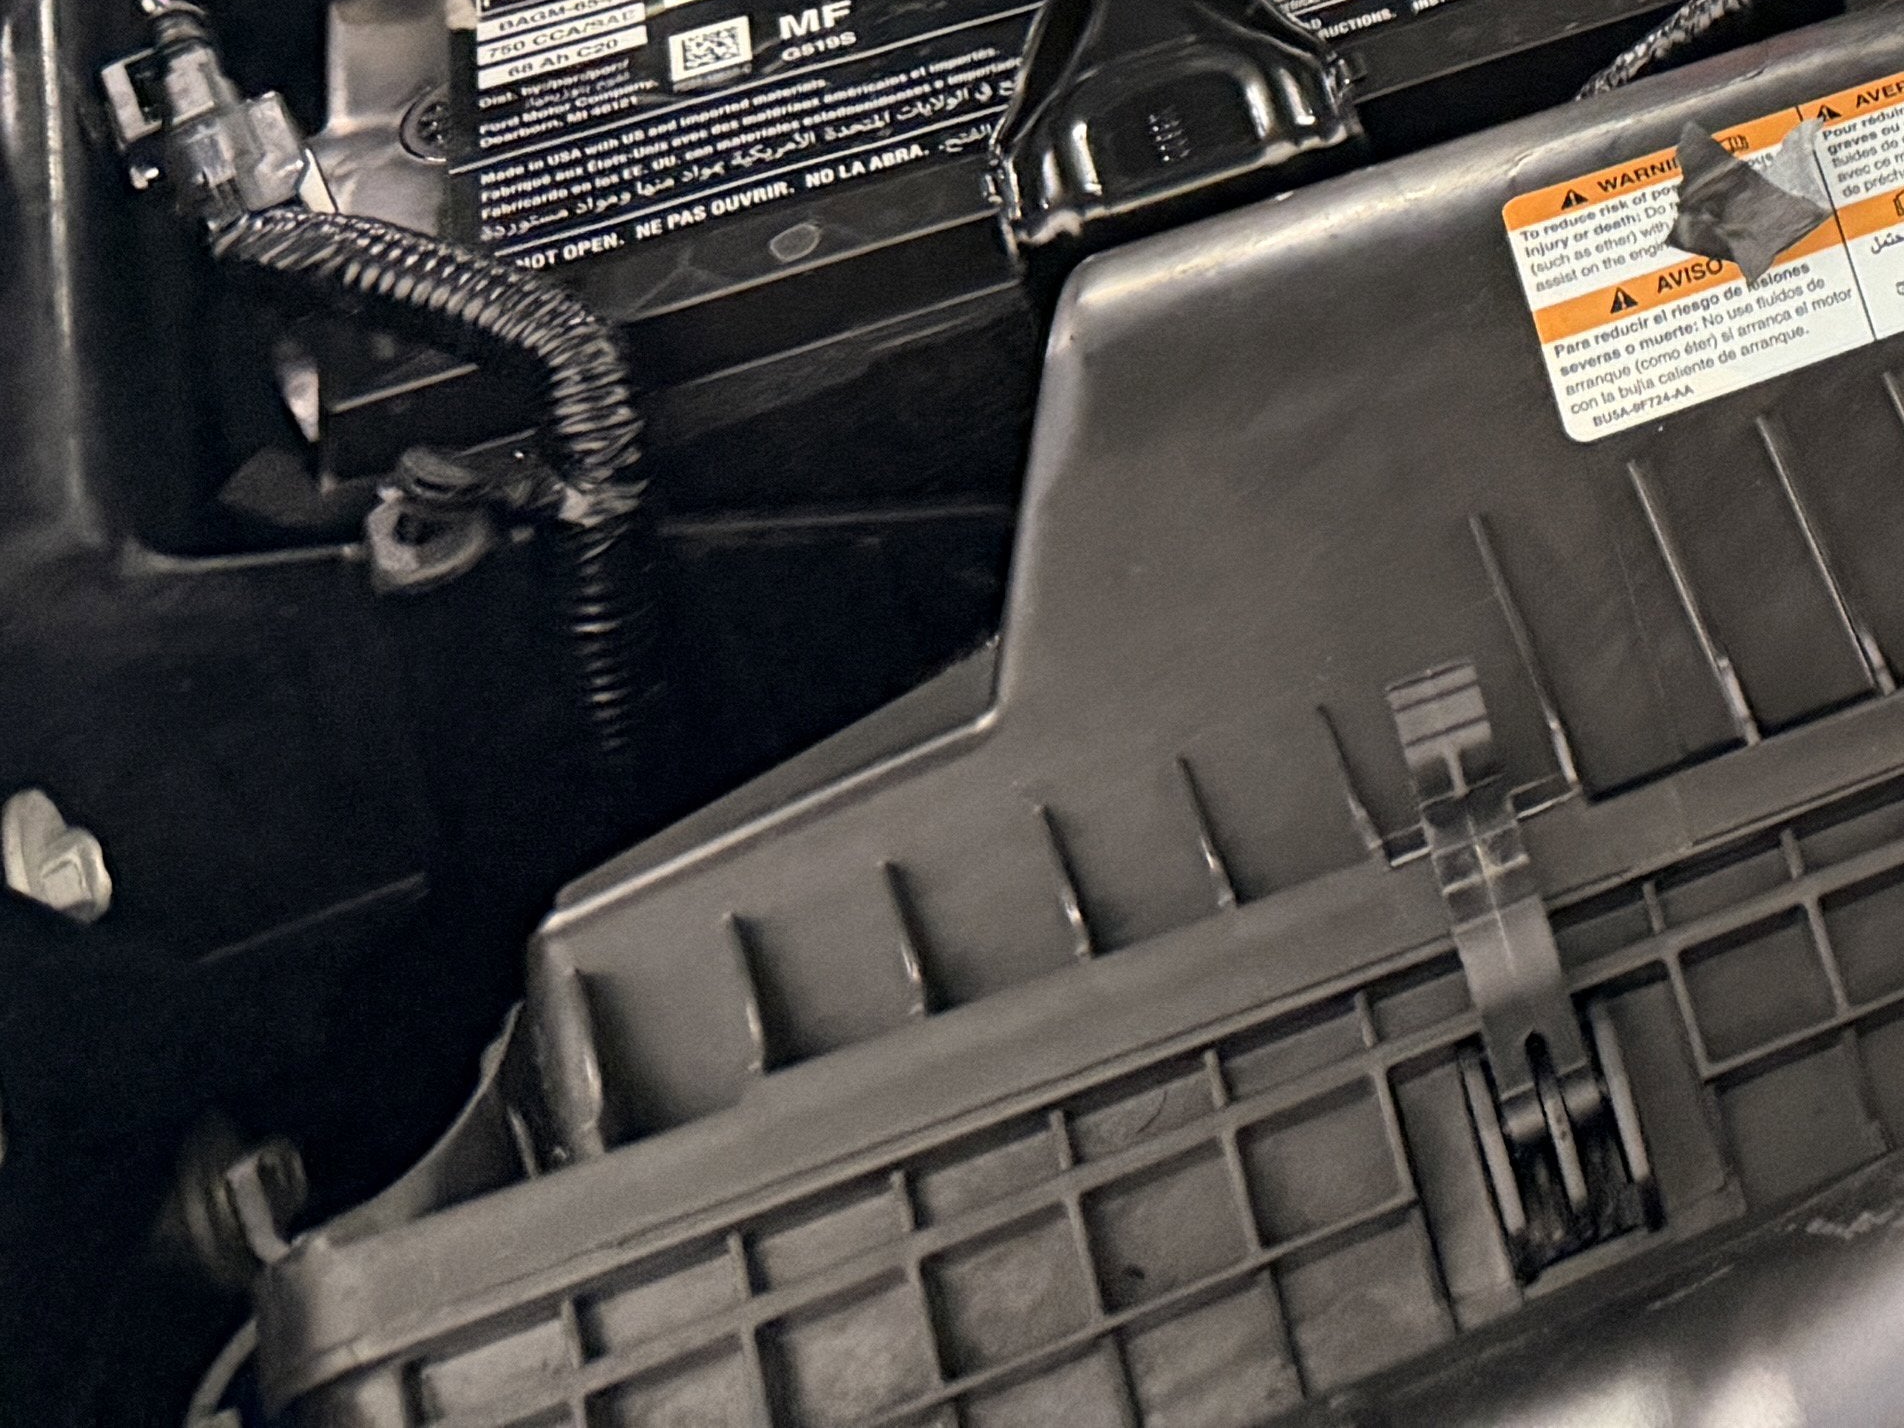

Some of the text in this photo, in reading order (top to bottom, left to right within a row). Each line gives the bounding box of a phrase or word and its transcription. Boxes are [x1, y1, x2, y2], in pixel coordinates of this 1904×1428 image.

[778, 0, 852, 41] MF
[488, 40, 526, 60] 750
[539, 51, 570, 70] Ah
[576, 37, 619, 58] C20
[479, 164, 525, 186] Made
[546, 147, 583, 167] USA
[584, 137, 620, 156] with
[621, 129, 647, 145] US
[647, 120, 677, 138] and
[679, 99, 750, 130] imported
[710, 120, 739, 137] des
[1822, 123, 1857, 142] Pour
[1827, 130, 1878, 157] graves
[1880, 122, 1901, 137] ou
[1881, 138, 1899, 154] de
[570, 181, 592, 196] en
[594, 172, 620, 189] los
[1837, 164, 1871, 184] avec
[562, 232, 625, 262] OPEN.
[635, 219, 663, 240] NE
[667, 205, 706, 230] PAS
[710, 179, 796, 217] OUVRIR.
[805, 170, 835, 189] NO
[838, 160, 865, 180] LA
[869, 143, 930, 172] ABRA.
[1520, 230, 1539, 243] To
[1543, 210, 1596, 236] reduce
[1599, 199, 1629, 218] risk
[1632, 191, 1648, 207] of
[1573, 228, 1590, 242] or
[1644, 204, 1667, 220] Do
[1530, 253, 1570, 277] (such
[1574, 247, 1592, 261] as
[1595, 230, 1637, 253] ether)
[1535, 272, 1576, 293] assist
[1581, 263, 1600, 279] on
[1602, 254, 1627, 270] the
[1656, 257, 1724, 294] AVISO
[1554, 337, 1591, 359] Para
[1594, 316, 1649, 345] reducir
[1671, 293, 1720, 320] riesgo
[1723, 284, 1743, 301] de
[1560, 347, 1622, 378] severas
[1639, 320, 1700, 351] muerte:
[1702, 312, 1724, 329] No
[1727, 303, 1754, 320] use
[1756, 285, 1804, 311] fluidos
[1807, 277, 1826, 292] de
[1566, 364, 1632, 396] arranque
[1635, 348, 1681, 374] (como
[1684, 333, 1719, 356] éter)
[1737, 310, 1793, 338] arranca
[1811, 287, 1853, 312] motor
[1570, 397, 1599, 415] con
[1658, 356, 1716, 385] caliente
[1718, 348, 1737, 365] de
[1740, 323, 1810, 357] arranque.
